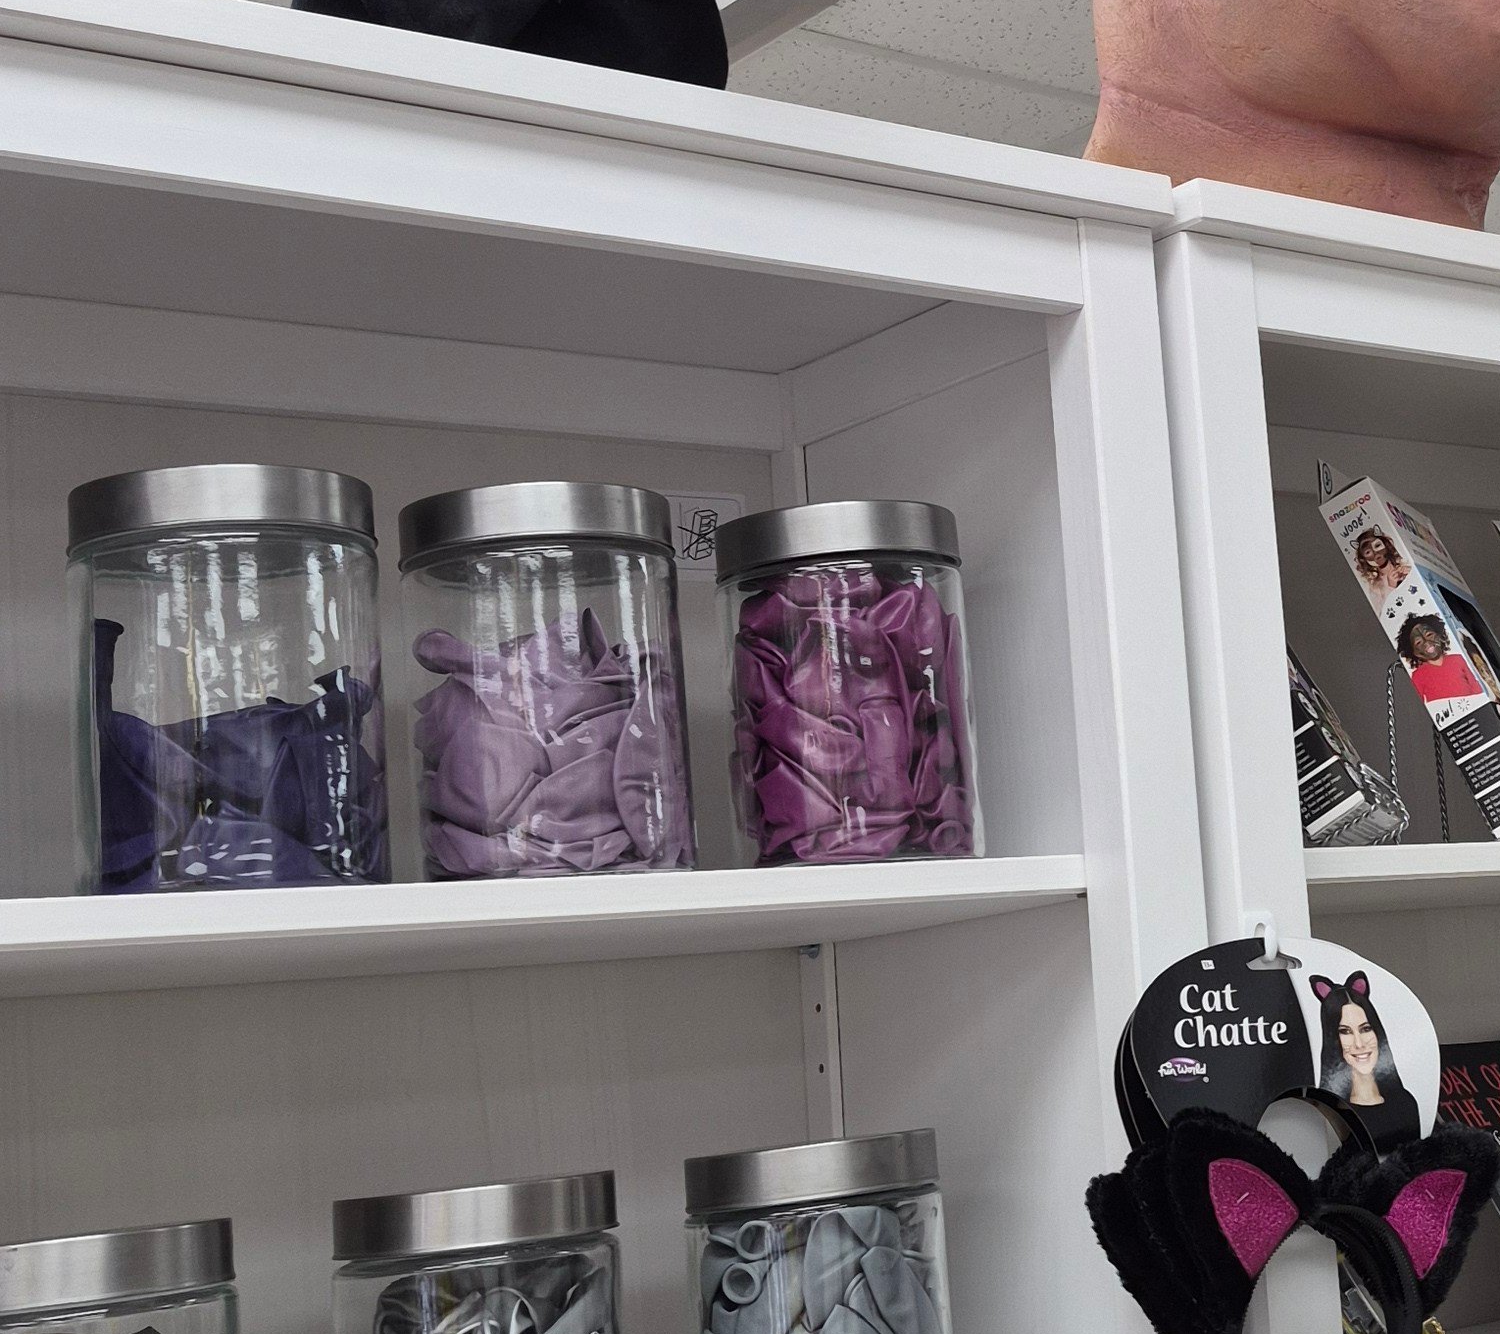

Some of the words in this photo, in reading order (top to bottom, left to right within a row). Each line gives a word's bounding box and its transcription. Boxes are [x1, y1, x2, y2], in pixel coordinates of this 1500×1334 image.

[1329, 492, 1371, 523] snazaroo
[1180, 983, 1239, 1014] Cat
[1174, 1015, 1288, 1049] Chatte
[1441, 1098, 1495, 1129] THE
